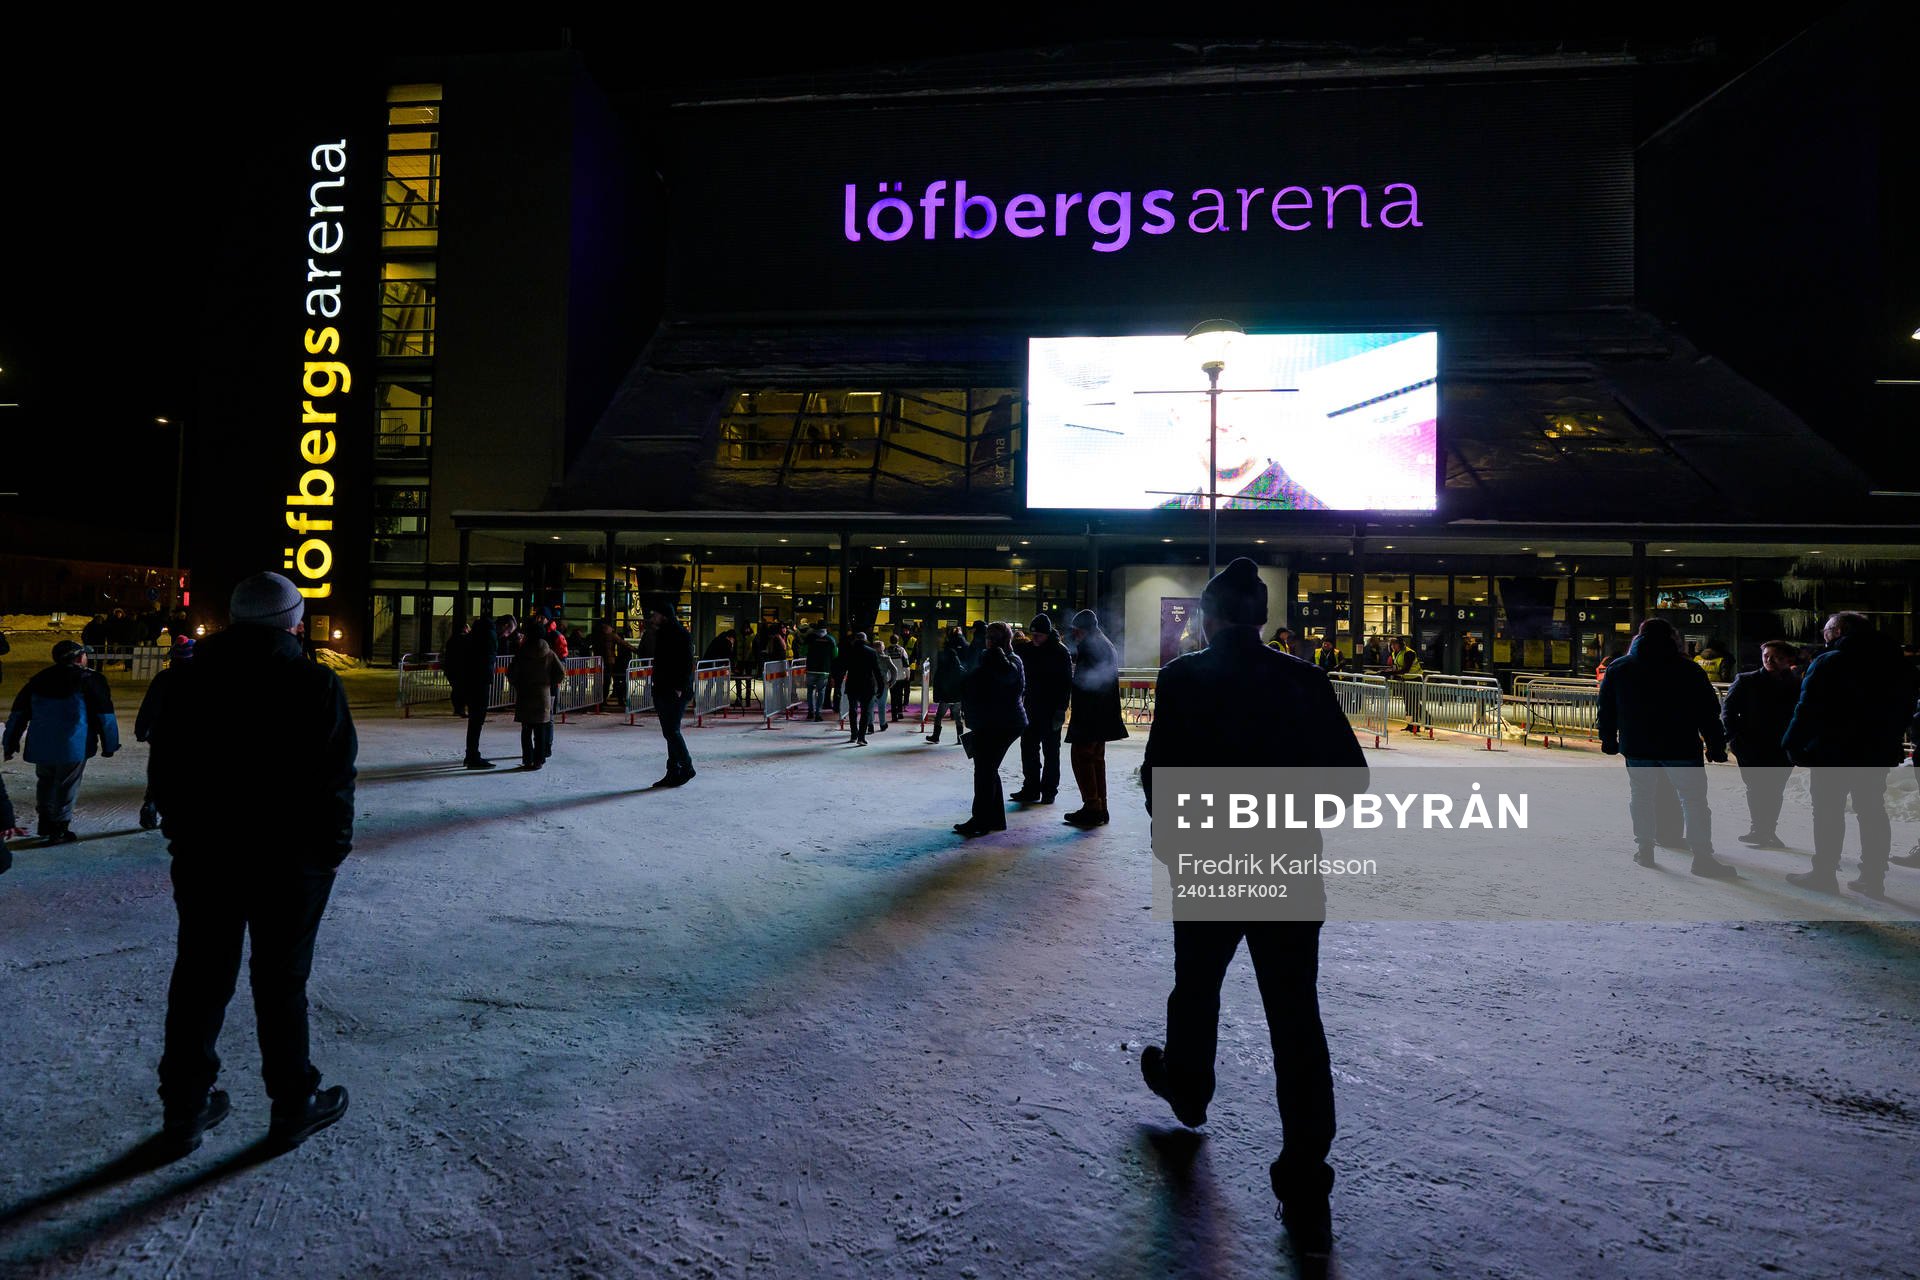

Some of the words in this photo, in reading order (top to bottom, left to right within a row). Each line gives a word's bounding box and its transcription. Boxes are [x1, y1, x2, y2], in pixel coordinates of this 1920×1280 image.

[721, 595, 728, 606] 1
[797, 597, 804, 607] 2
[900, 600, 907, 609] 3
[935, 600, 943, 609] 4
[1042, 601, 1049, 611] 5
[1302, 606, 1309, 616] 6
[1419, 609, 1426, 619] 7
[1457, 610, 1465, 620] 8
[1578, 611, 1587, 622] 9
[1689, 613, 1703, 624] 10
